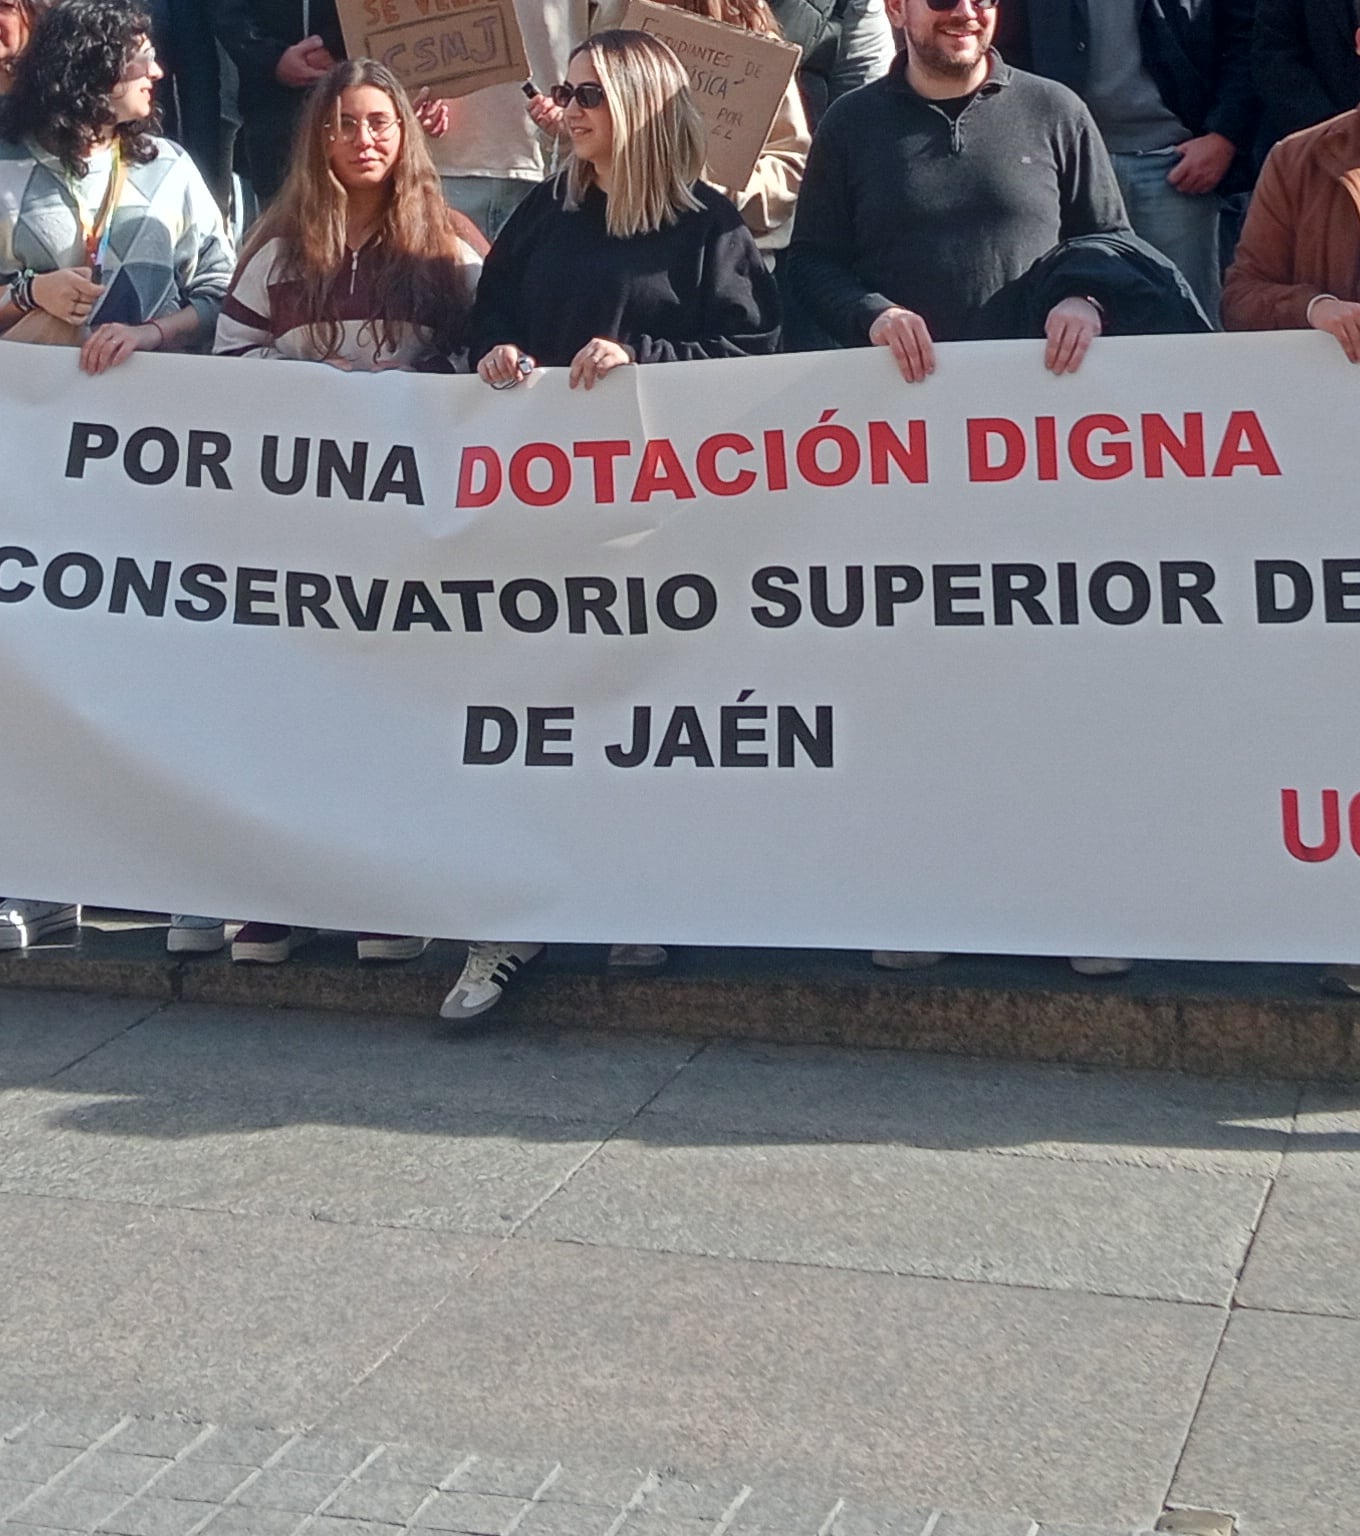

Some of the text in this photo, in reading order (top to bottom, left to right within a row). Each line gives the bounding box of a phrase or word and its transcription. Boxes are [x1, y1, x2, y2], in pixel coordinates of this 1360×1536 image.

[383, 15, 497, 77] CSMJ
[744, 60, 762, 80] DE
[64, 408, 1283, 509] POR UNA DOTACIÓN DIGNA
[750, 559, 1224, 628] SUPERIOR
[462, 689, 835, 769] DE JAÉN
